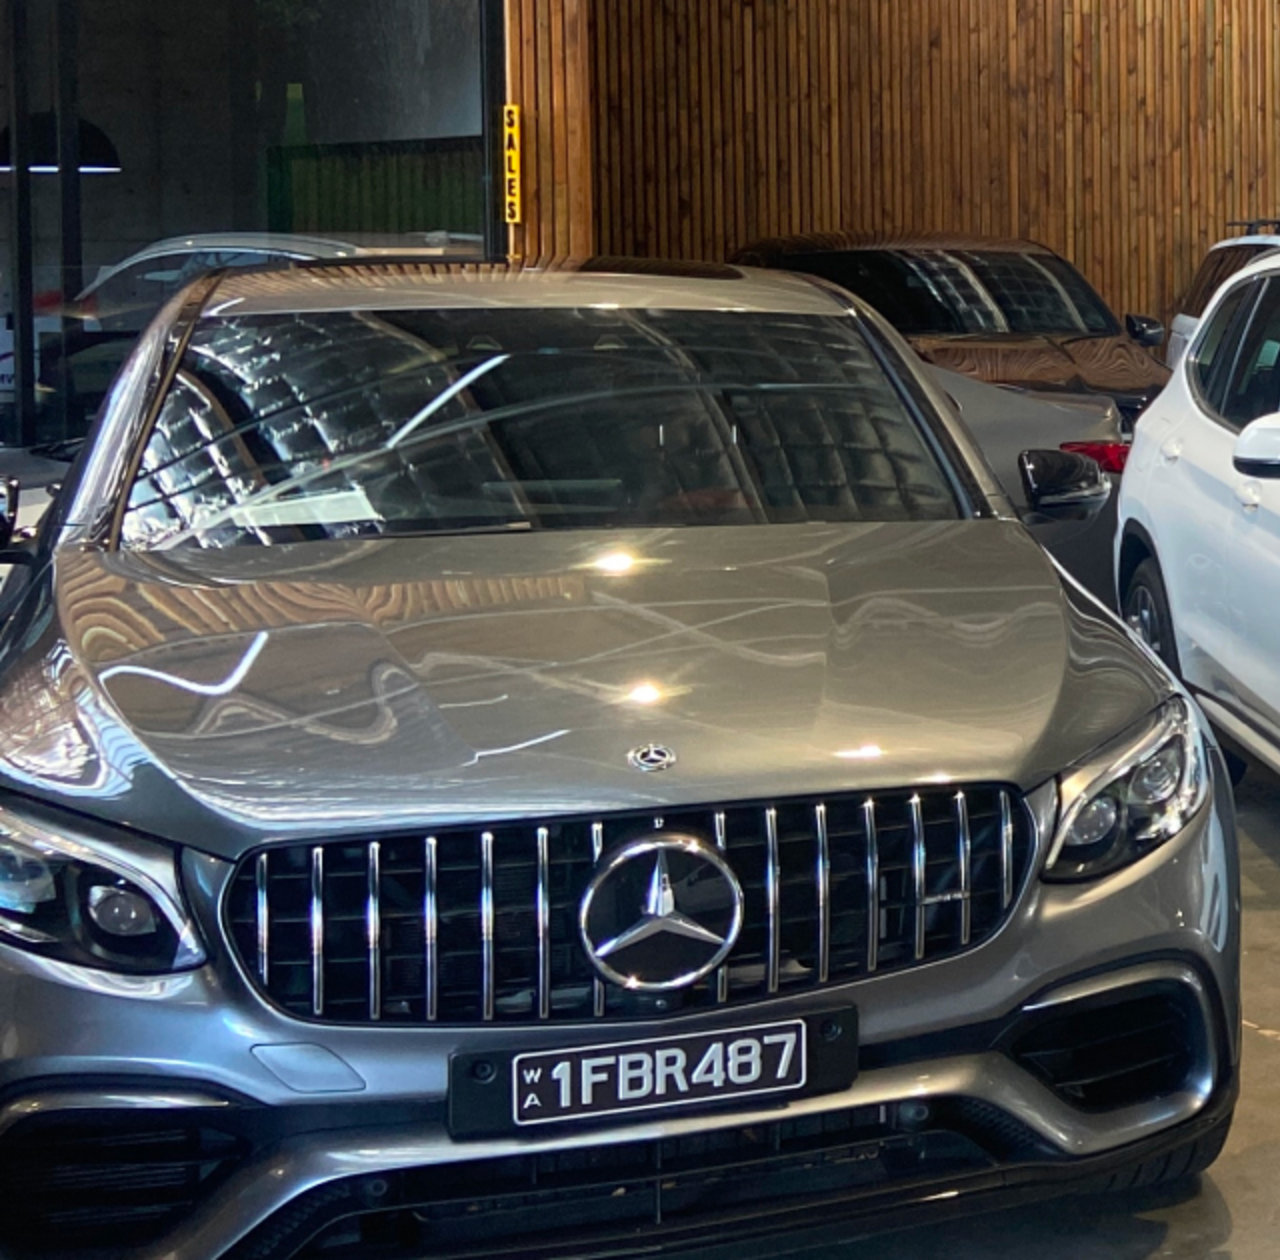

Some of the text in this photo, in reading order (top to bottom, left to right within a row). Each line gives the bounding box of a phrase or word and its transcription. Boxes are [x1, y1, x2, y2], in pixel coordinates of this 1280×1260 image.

[506, 108, 517, 220] SALES
[522, 1067, 543, 1085] W
[550, 1032, 798, 1109] 1FBR487
[522, 1092, 543, 1109] A
